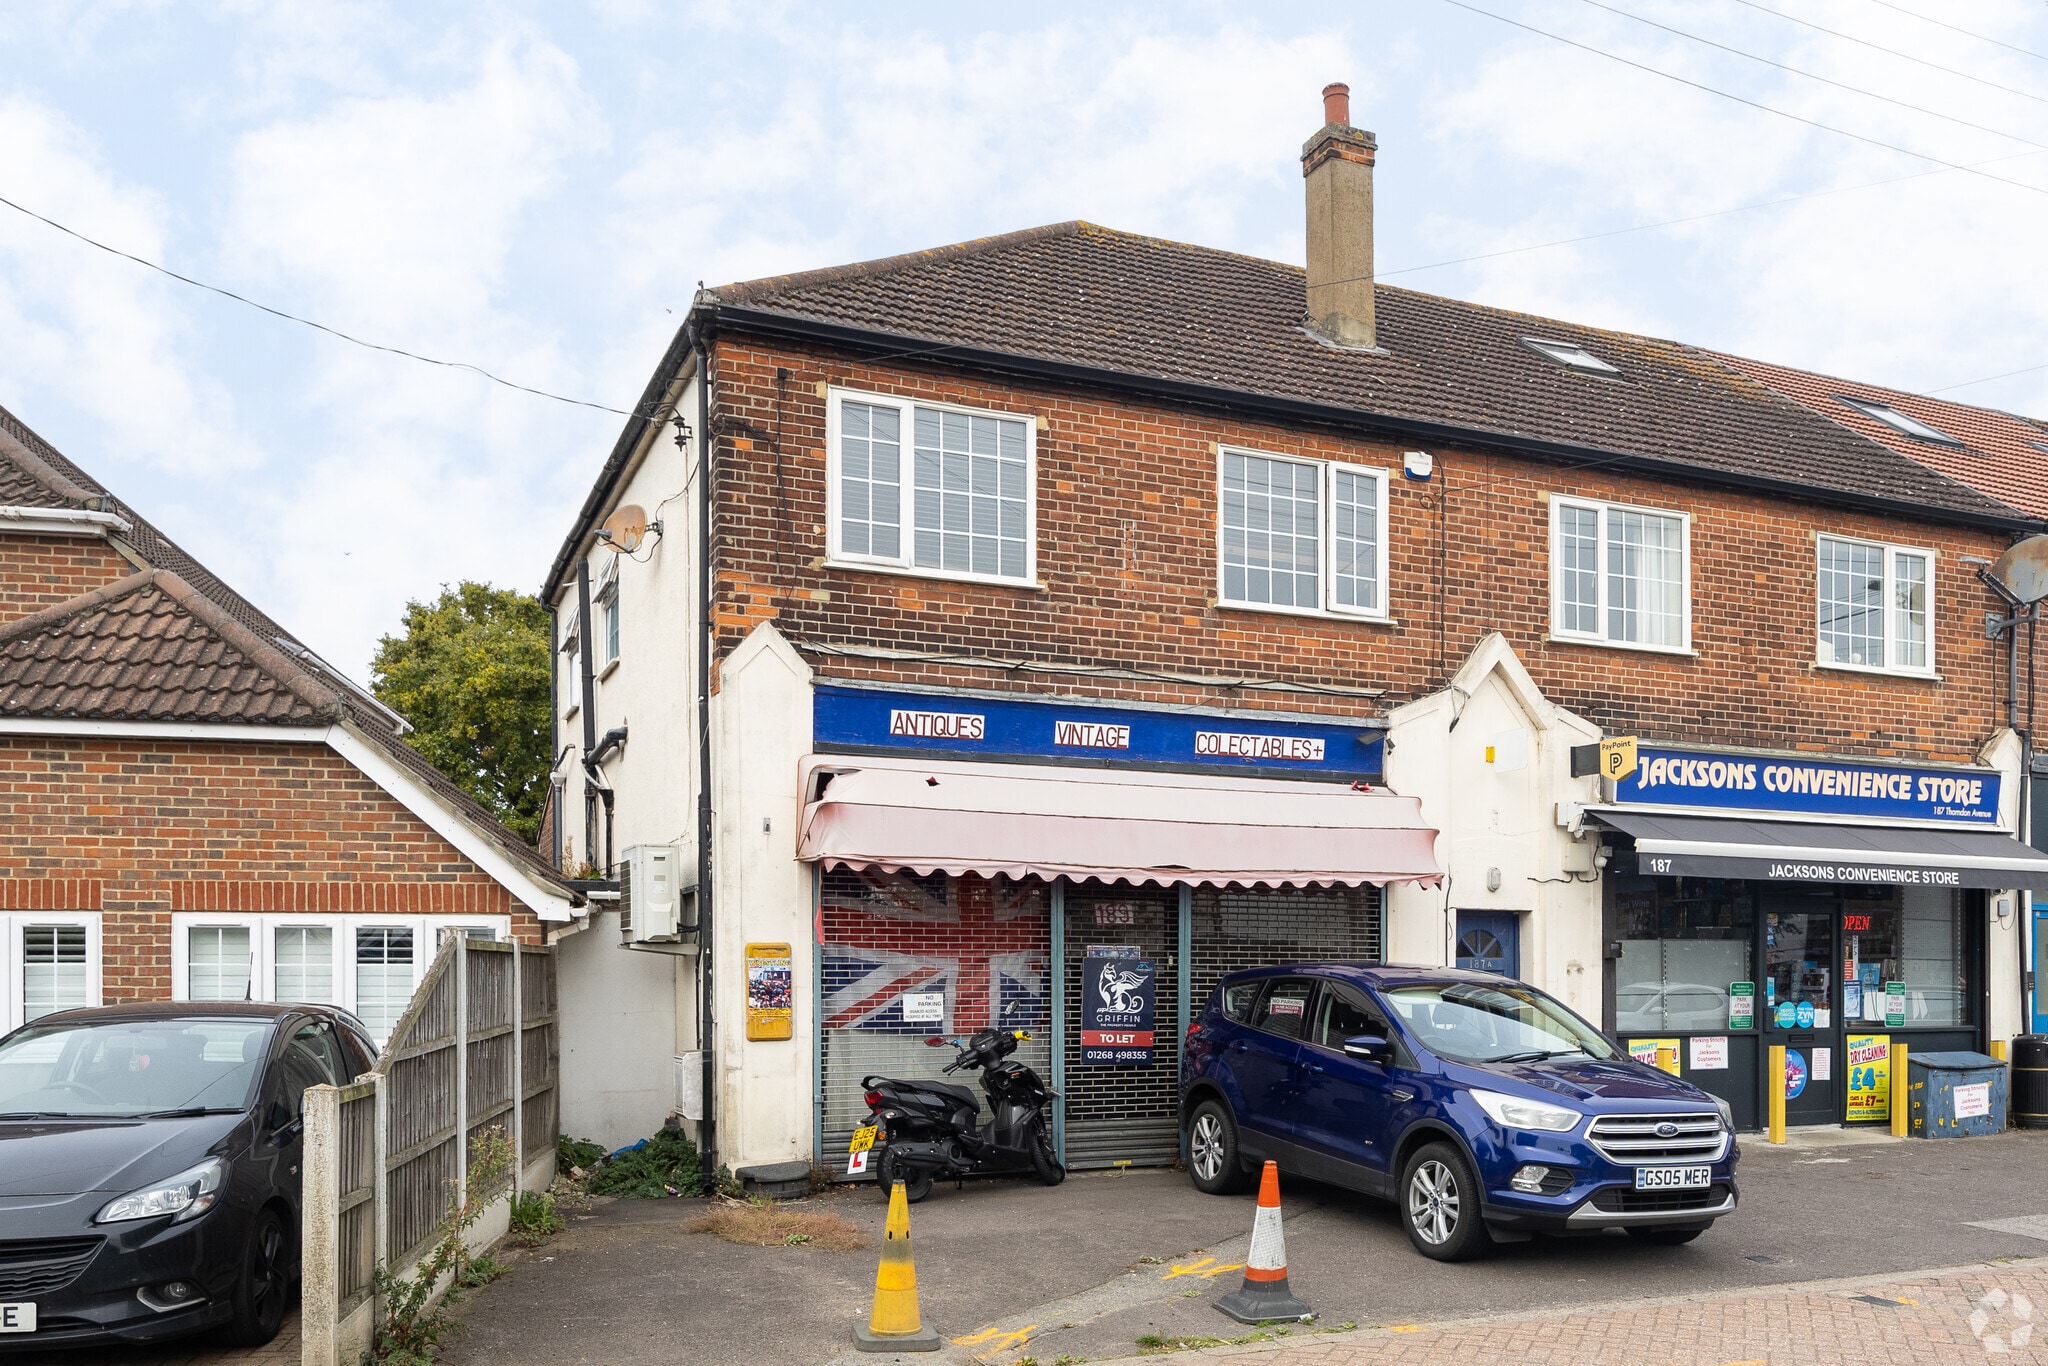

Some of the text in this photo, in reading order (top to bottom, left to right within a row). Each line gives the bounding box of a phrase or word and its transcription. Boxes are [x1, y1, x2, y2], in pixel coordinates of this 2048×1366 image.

[892, 712, 983, 738] ANTIQUES
[1057, 723, 1129, 748] VINTAGE
[1197, 733, 1323, 760] COLECTABLES+
[1602, 740, 1631, 750] PayPoint
[1637, 756, 1982, 807] JACKSONS CONVENIENCE STORE
[1933, 806, 1945, 815] 187
[1972, 808, 1992, 818] Avenue
[1650, 858, 1672, 873] 187
[1768, 864, 1960, 885] JACKSONS CONVENIENCE STORE
[1097, 904, 1129, 924] 189
[1470, 959, 1492, 969] 187A
[1797, 1011, 1813, 1019] ZYN
[1100, 1034, 1135, 1043] TO LET
[1849, 1038, 1873, 1049] QUALITY
[1630, 1042, 1658, 1053] QUALITY
[1850, 1045, 1886, 1064] DRY CLEANING
[1087, 1051, 1147, 1060] 01268 498355
[1850, 1067, 1875, 1091] £4
[1865, 1095, 1876, 1106] £7
[854, 1127, 876, 1141] EJ25
[852, 1152, 862, 1168] L
[1646, 1169, 1709, 1185] GS05 MER
